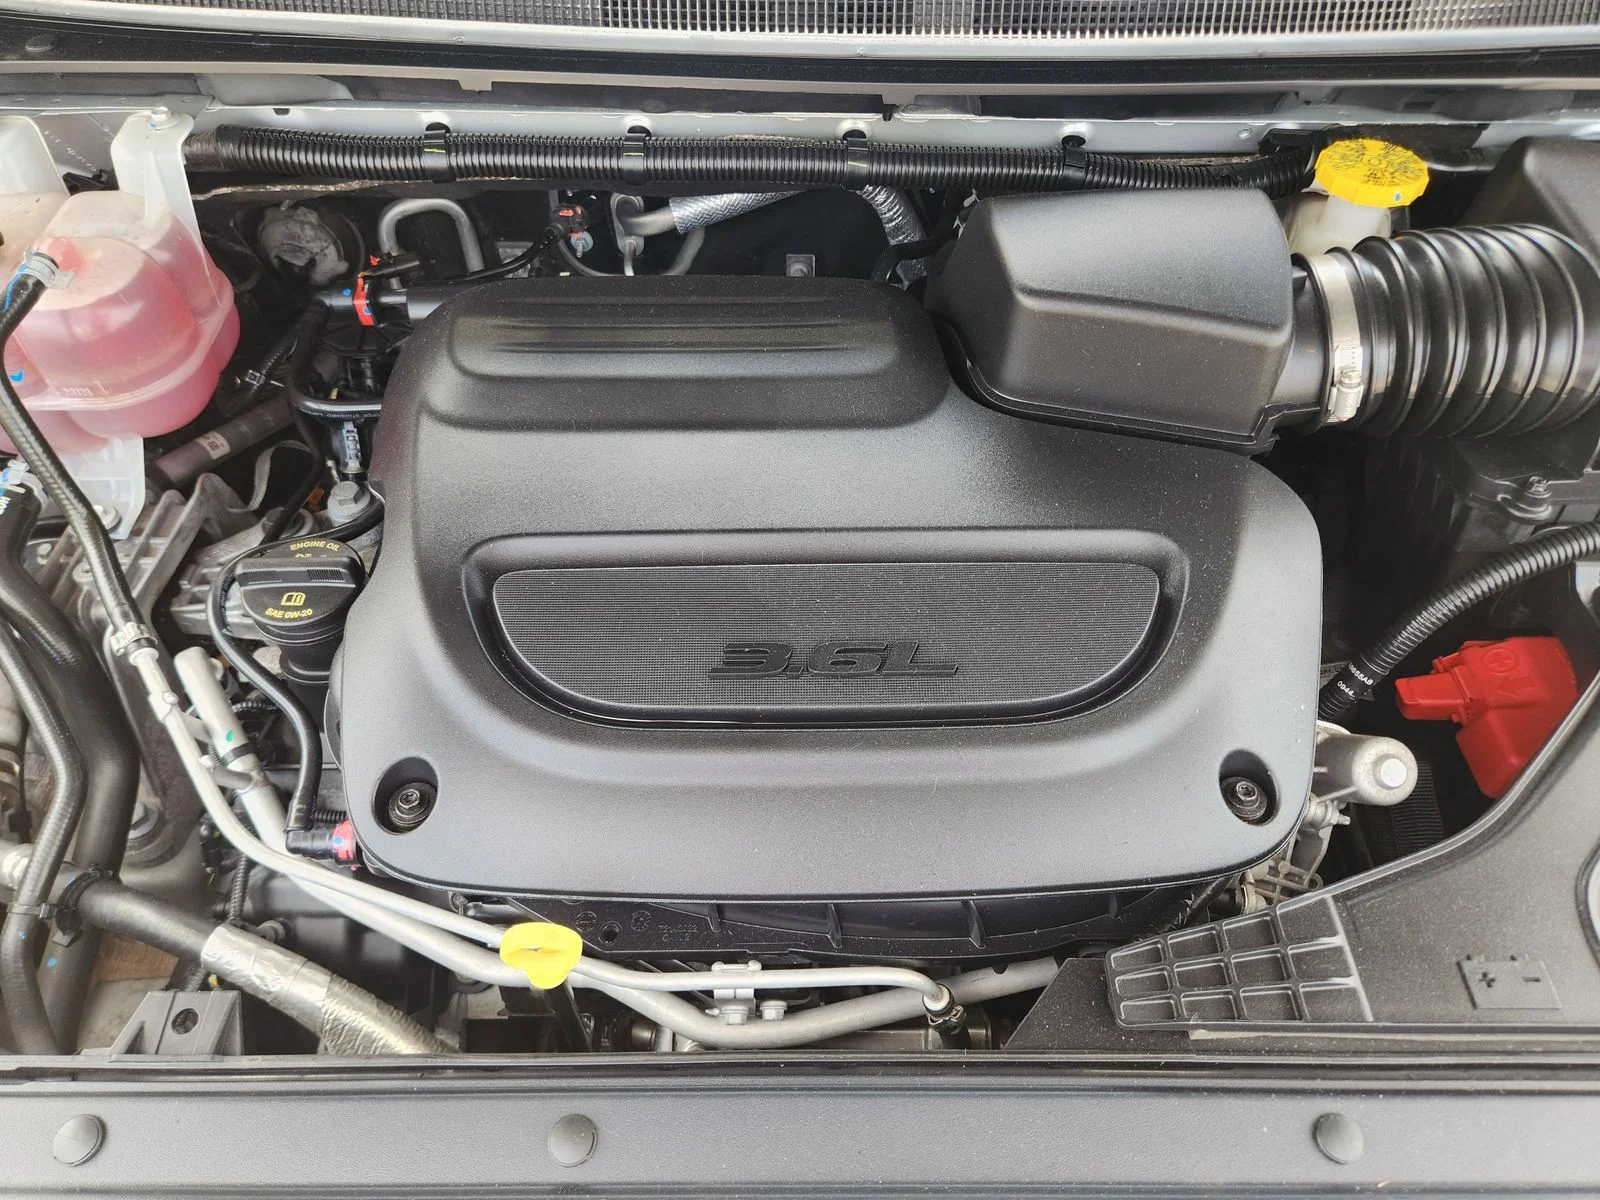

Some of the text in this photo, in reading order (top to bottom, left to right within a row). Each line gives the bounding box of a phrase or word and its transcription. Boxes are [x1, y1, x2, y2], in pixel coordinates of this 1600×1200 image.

[290, 541, 341, 552] ENGINE OIL
[265, 608, 313, 619] SAE 0W-20
[709, 640, 958, 679] 3.6L
